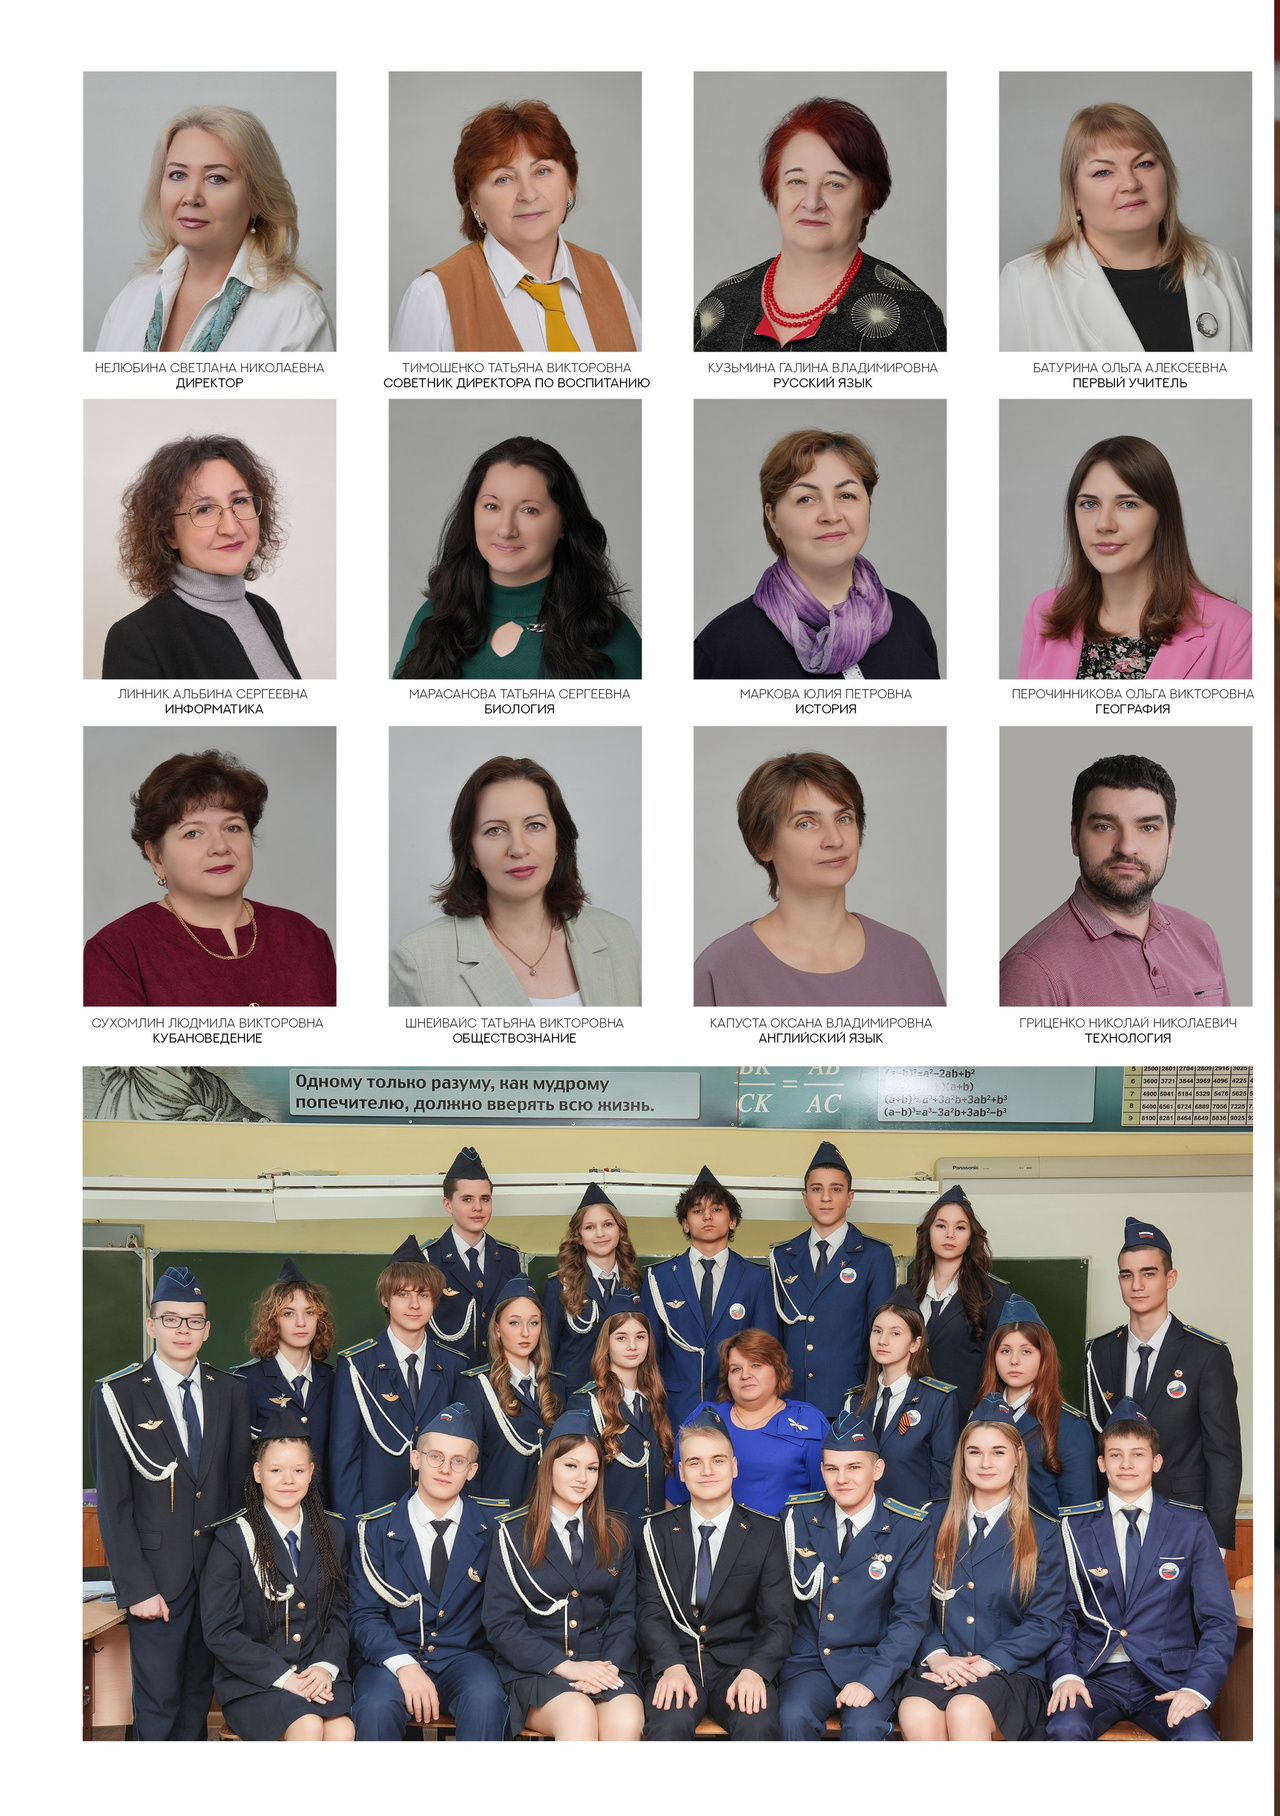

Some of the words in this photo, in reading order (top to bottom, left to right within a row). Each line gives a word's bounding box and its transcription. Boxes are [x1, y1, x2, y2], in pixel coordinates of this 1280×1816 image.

[295, 1073, 362, 1090] Одному
[366, 1077, 427, 1089] только
[431, 1078, 495, 1092] разуму,
[499, 1079, 529, 1090] как
[533, 1079, 609, 1093] мудрому
[296, 1098, 409, 1112] попечителю,
[414, 1099, 482, 1113] должно
[487, 1099, 555, 1113] вверять
[559, 1100, 593, 1111] всю
[597, 1100, 655, 1112] жизнь.
[806, 1093, 842, 1113] AC
